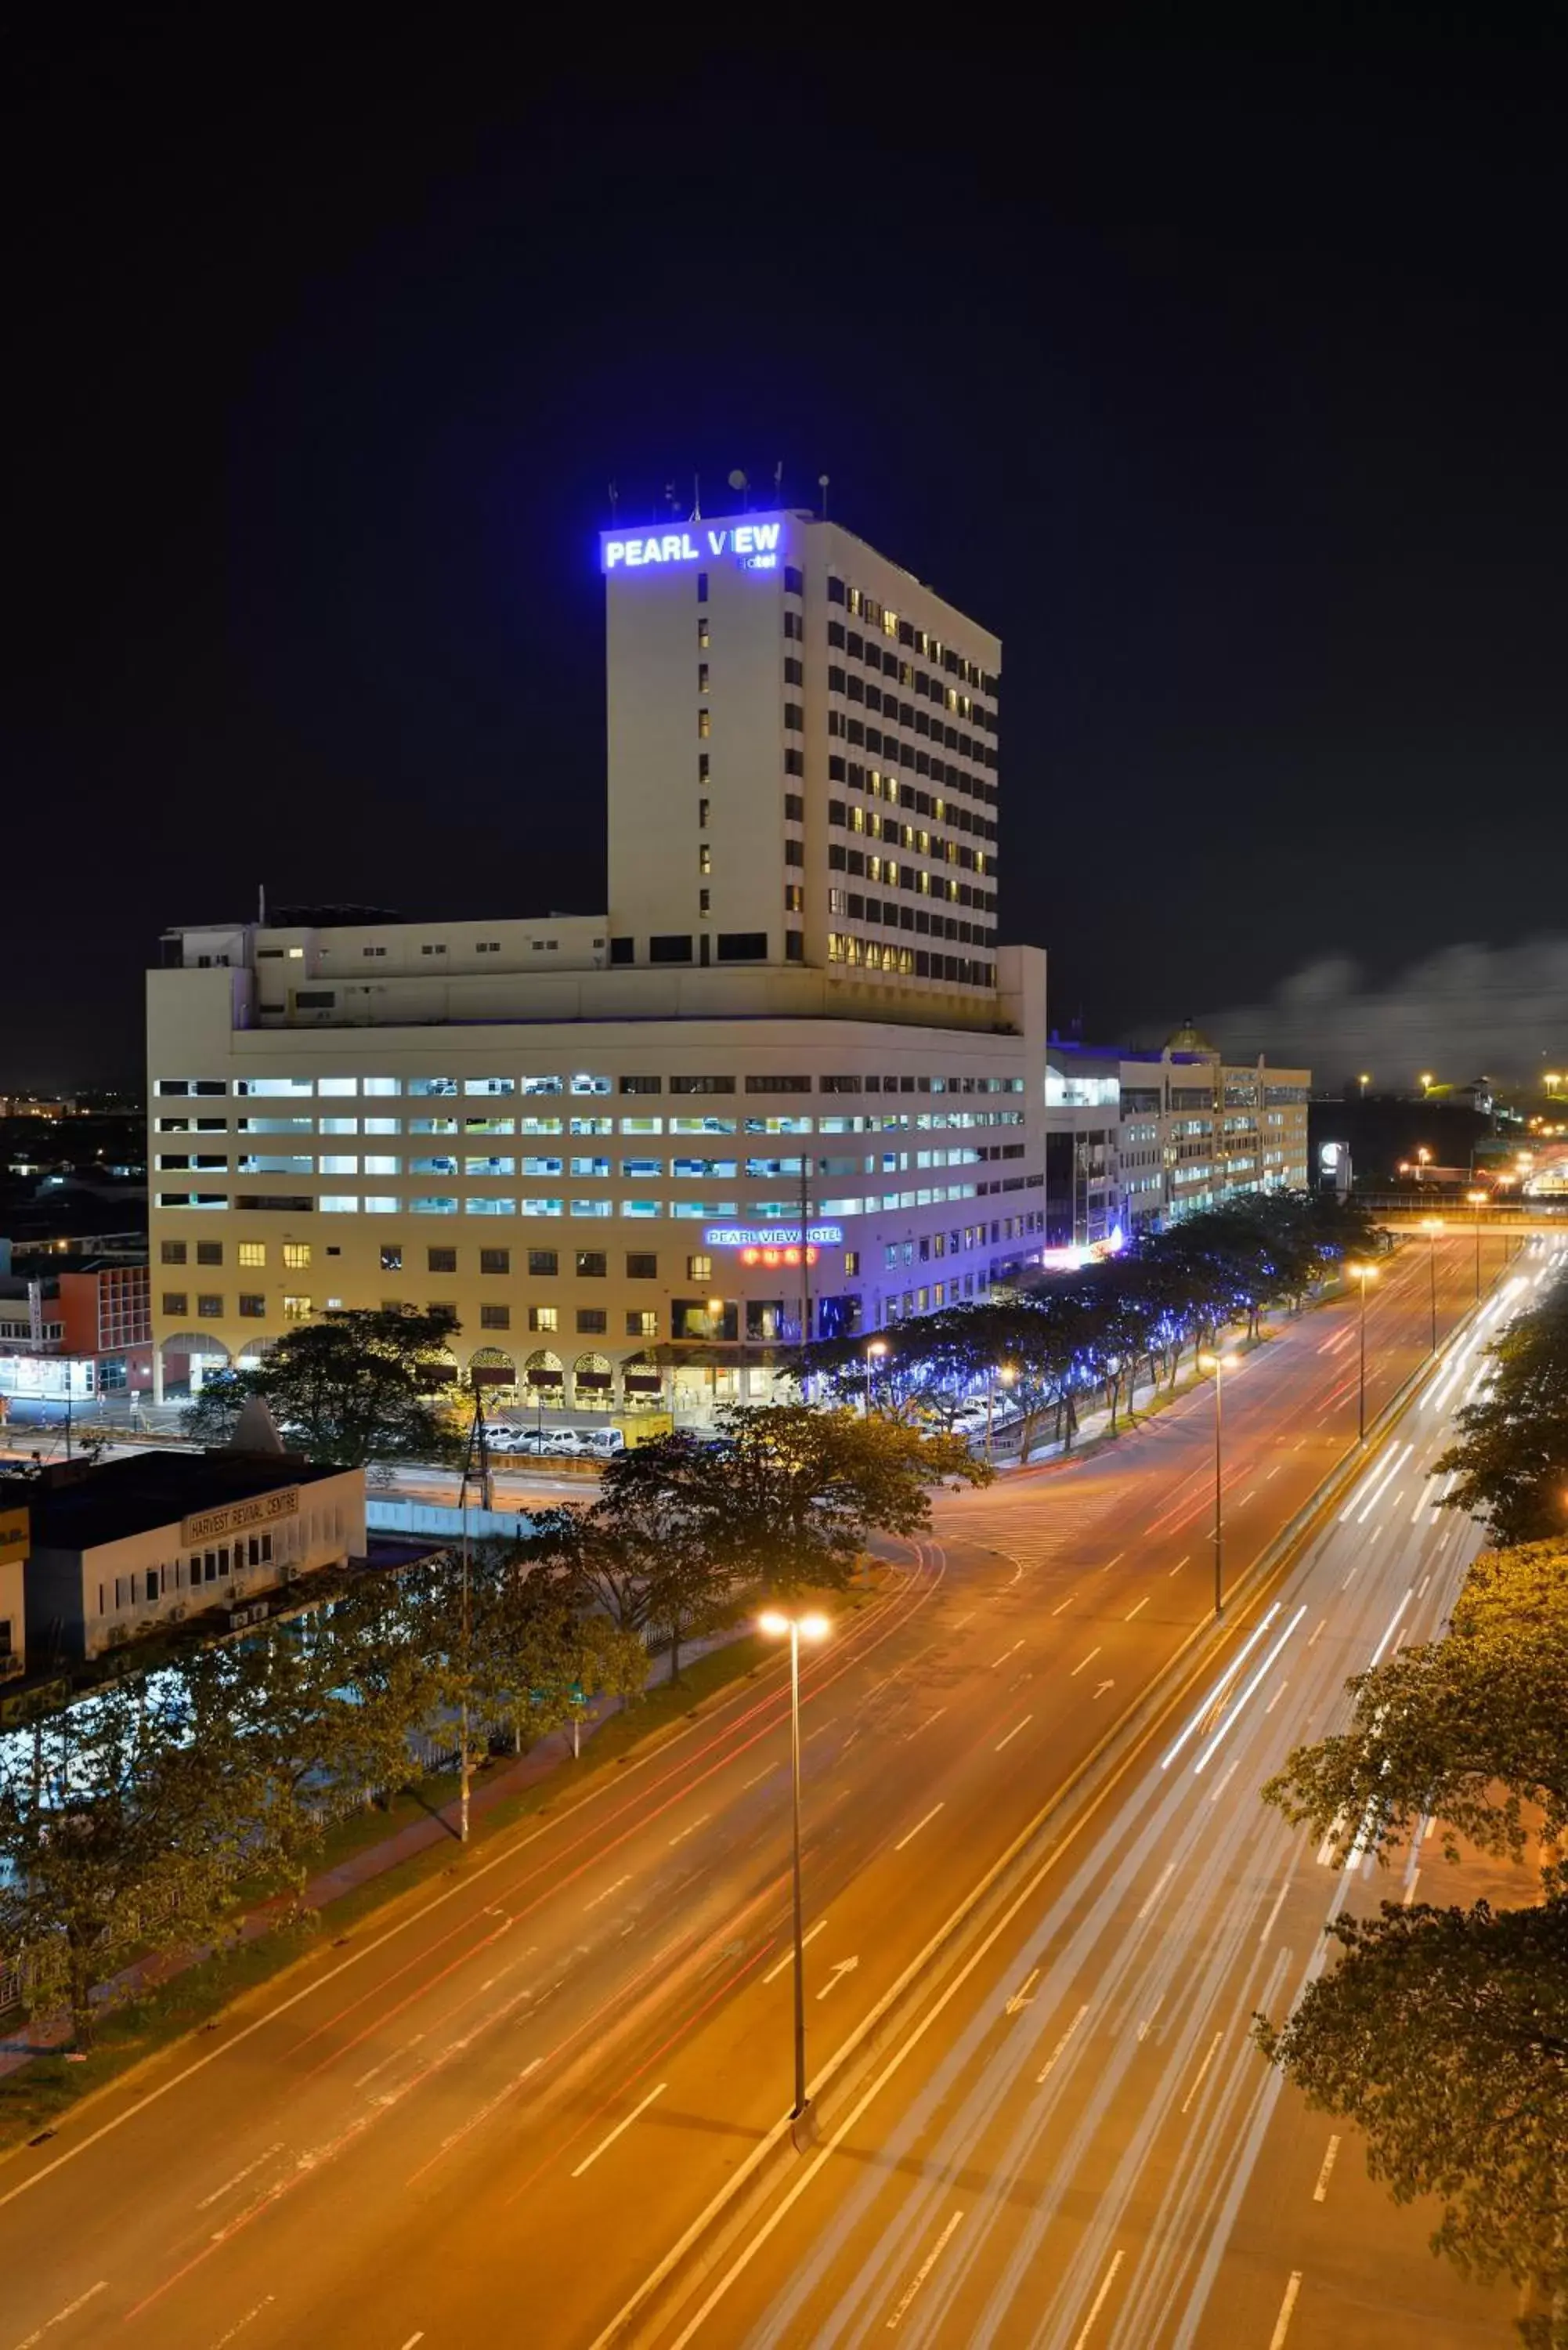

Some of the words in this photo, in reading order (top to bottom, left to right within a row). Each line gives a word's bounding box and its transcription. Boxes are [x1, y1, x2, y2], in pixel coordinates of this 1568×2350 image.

[606, 534, 699, 568] PEARL
[707, 522, 780, 555] VIEW
[708, 1231, 757, 1244] PEARL
[761, 1231, 798, 1242] VIEW
[191, 1513, 228, 1539] HARVEST
[267, 1492, 296, 1515] CENTRE
